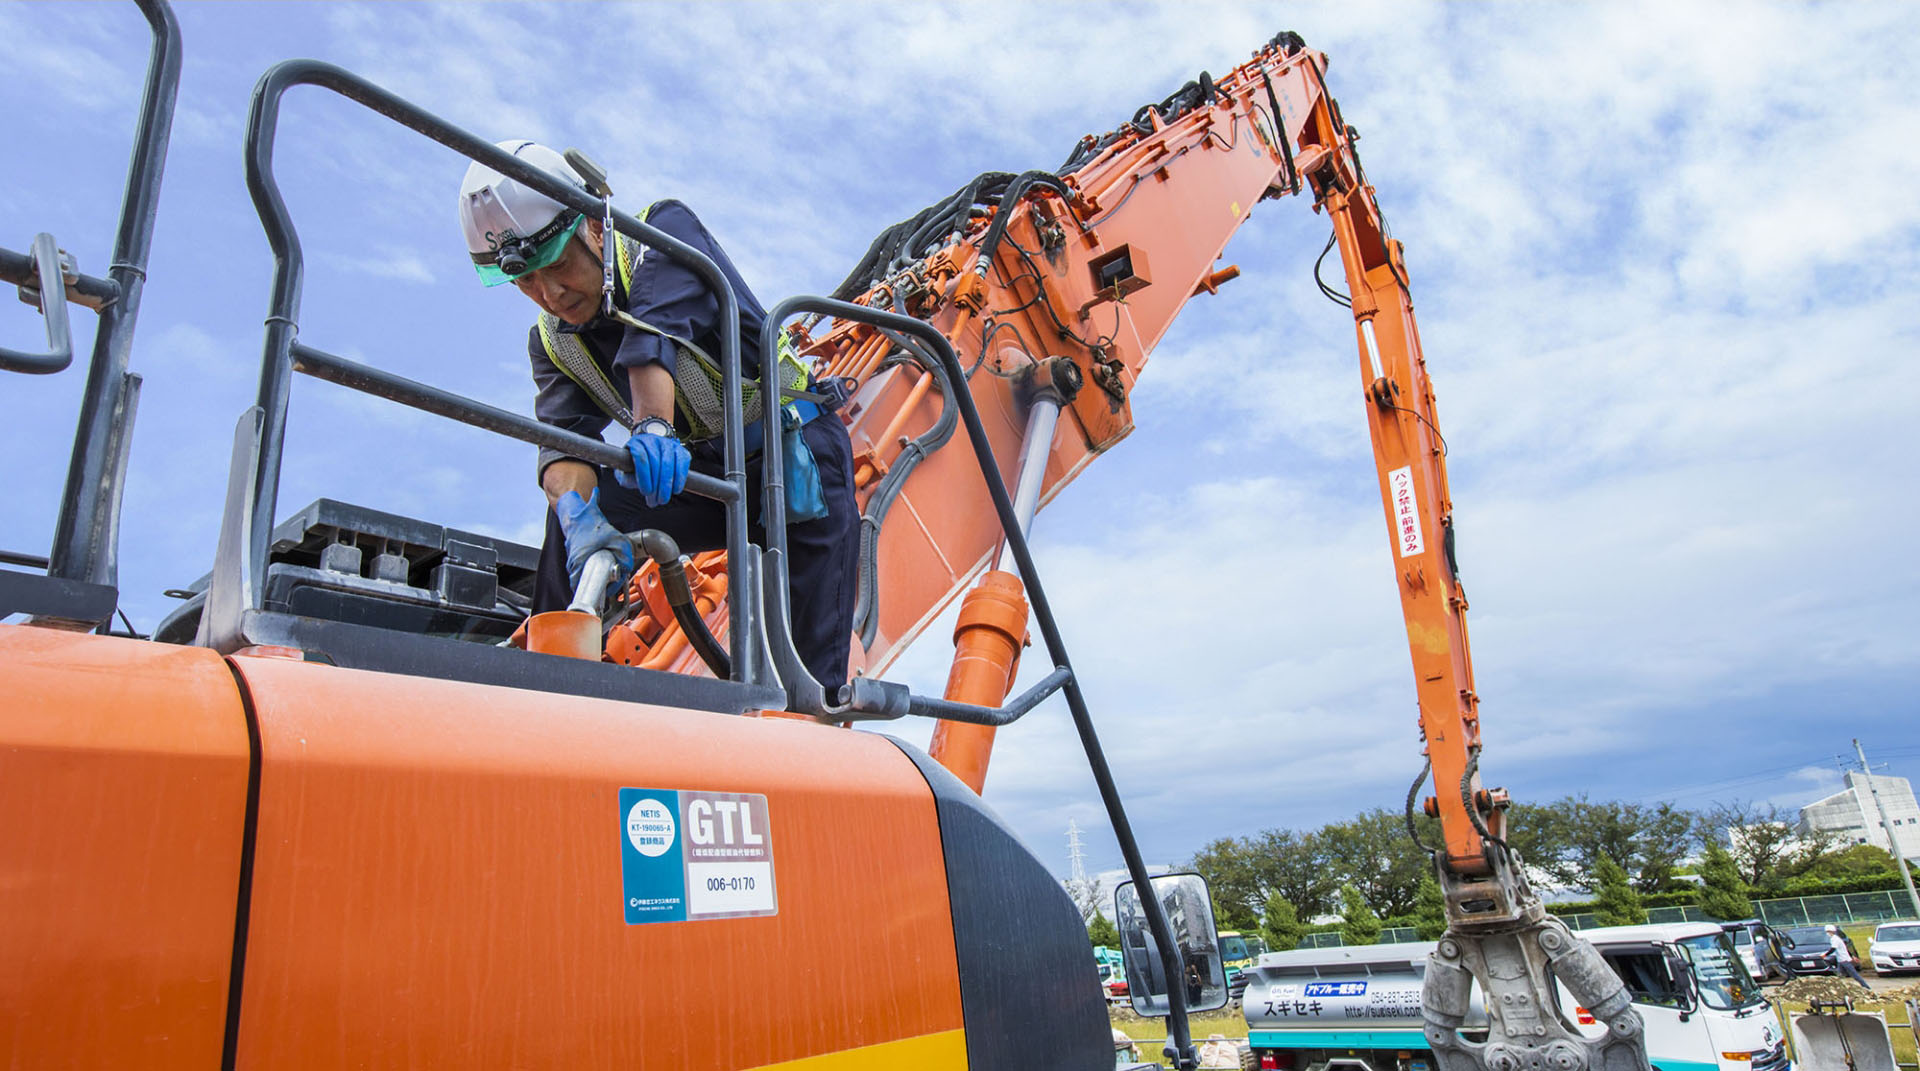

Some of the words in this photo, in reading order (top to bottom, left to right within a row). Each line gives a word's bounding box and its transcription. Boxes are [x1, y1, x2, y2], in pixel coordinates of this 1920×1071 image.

[640, 809, 661, 819] NETIS
[688, 799, 764, 845] GTL
[706, 876, 756, 892] 006-0170
[1264, 999, 1323, 1017] スギセキ
